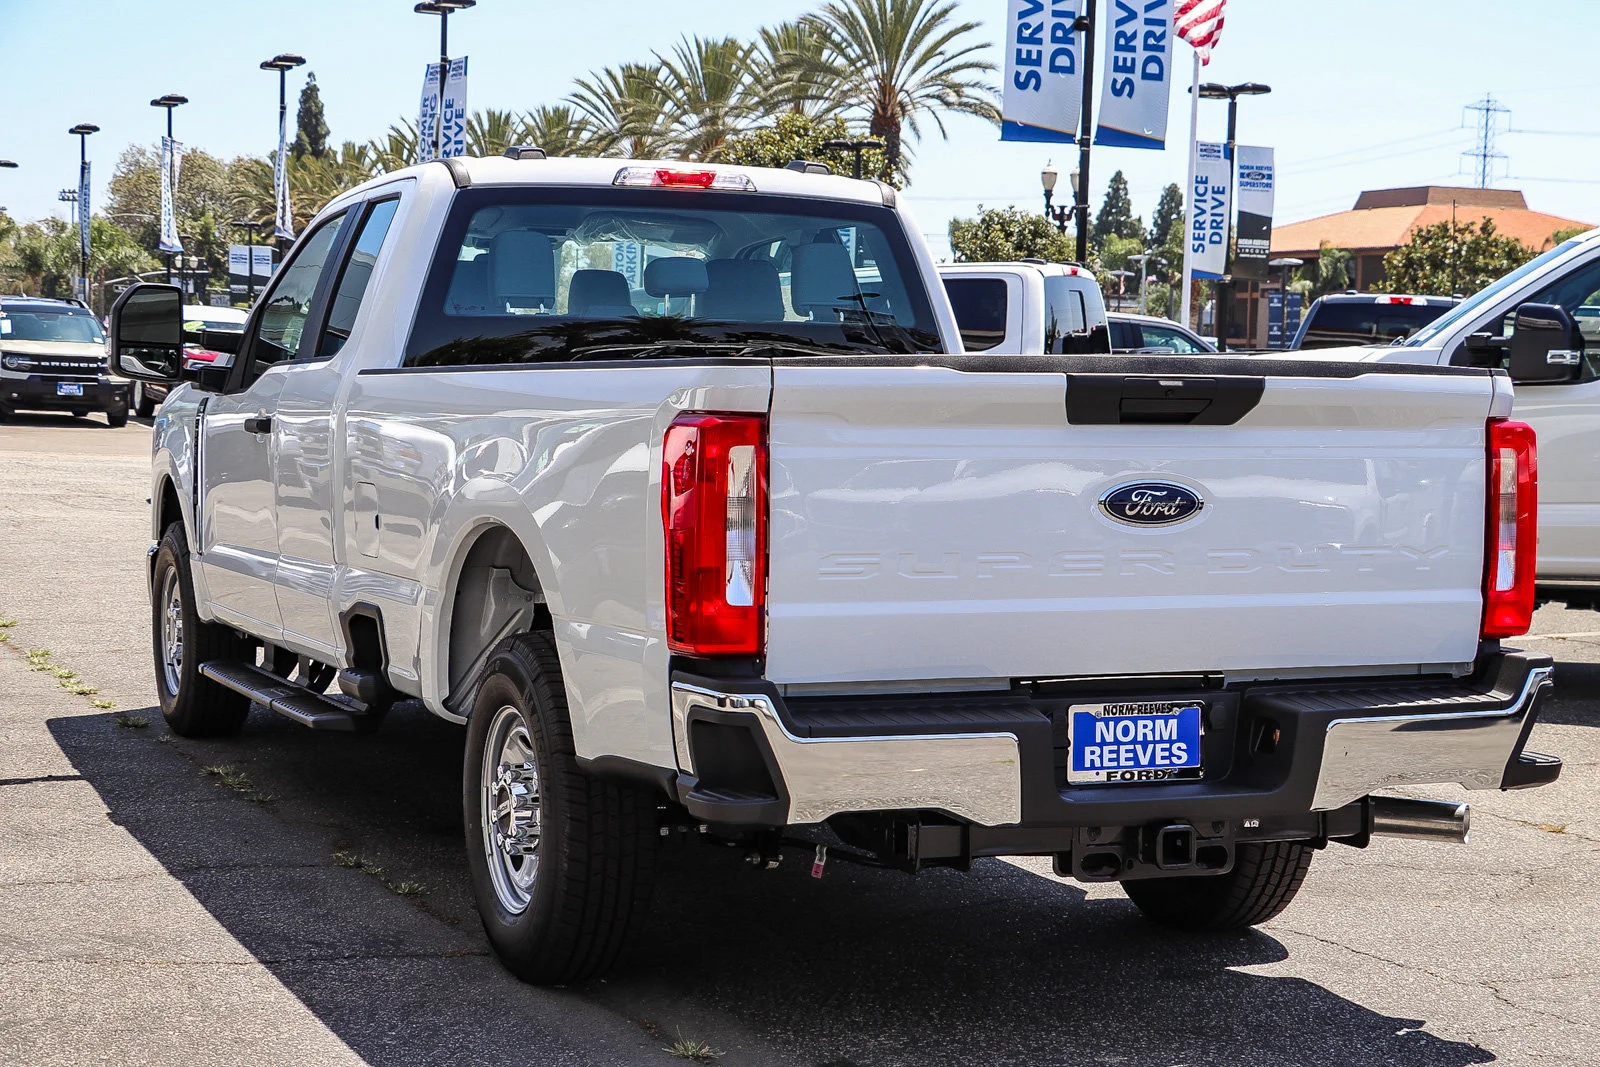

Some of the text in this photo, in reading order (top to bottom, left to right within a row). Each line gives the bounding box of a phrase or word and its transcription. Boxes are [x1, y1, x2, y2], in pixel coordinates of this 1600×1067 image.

[1049, 0, 1076, 74] DRI
[1111, 0, 1138, 99] SERV
[1192, 175, 1209, 253] SERVICE
[1209, 185, 1226, 245] DRIVE
[1125, 489, 1185, 516] Ford
[818, 543, 1449, 580] SUPER DUTY
[1103, 703, 1173, 717] NORM REEVES
[1095, 719, 1178, 743] NORM
[1084, 742, 1188, 768] REEVES
[1106, 770, 1169, 781] FORD
